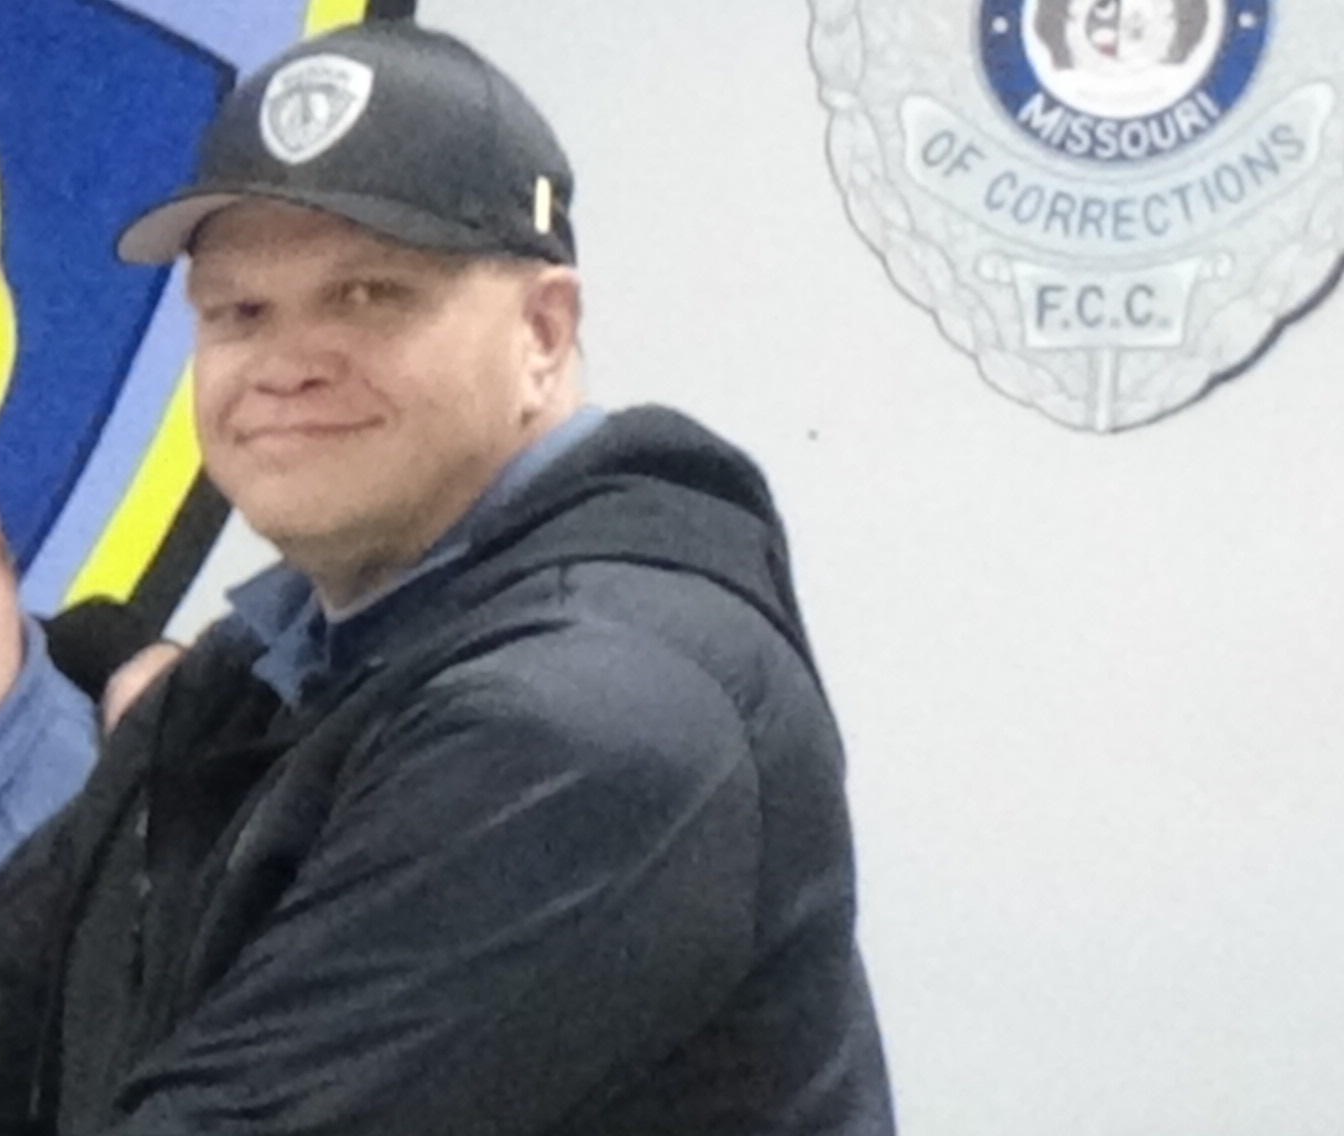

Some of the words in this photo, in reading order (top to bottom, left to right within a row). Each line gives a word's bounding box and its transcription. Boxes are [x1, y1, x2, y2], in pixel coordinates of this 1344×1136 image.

[1017, 91, 1221, 159] MISSOURI
[920, 130, 987, 178] OF
[983, 123, 1306, 241] CORRECTIONS
[1035, 283, 1172, 331] F.C.C.
